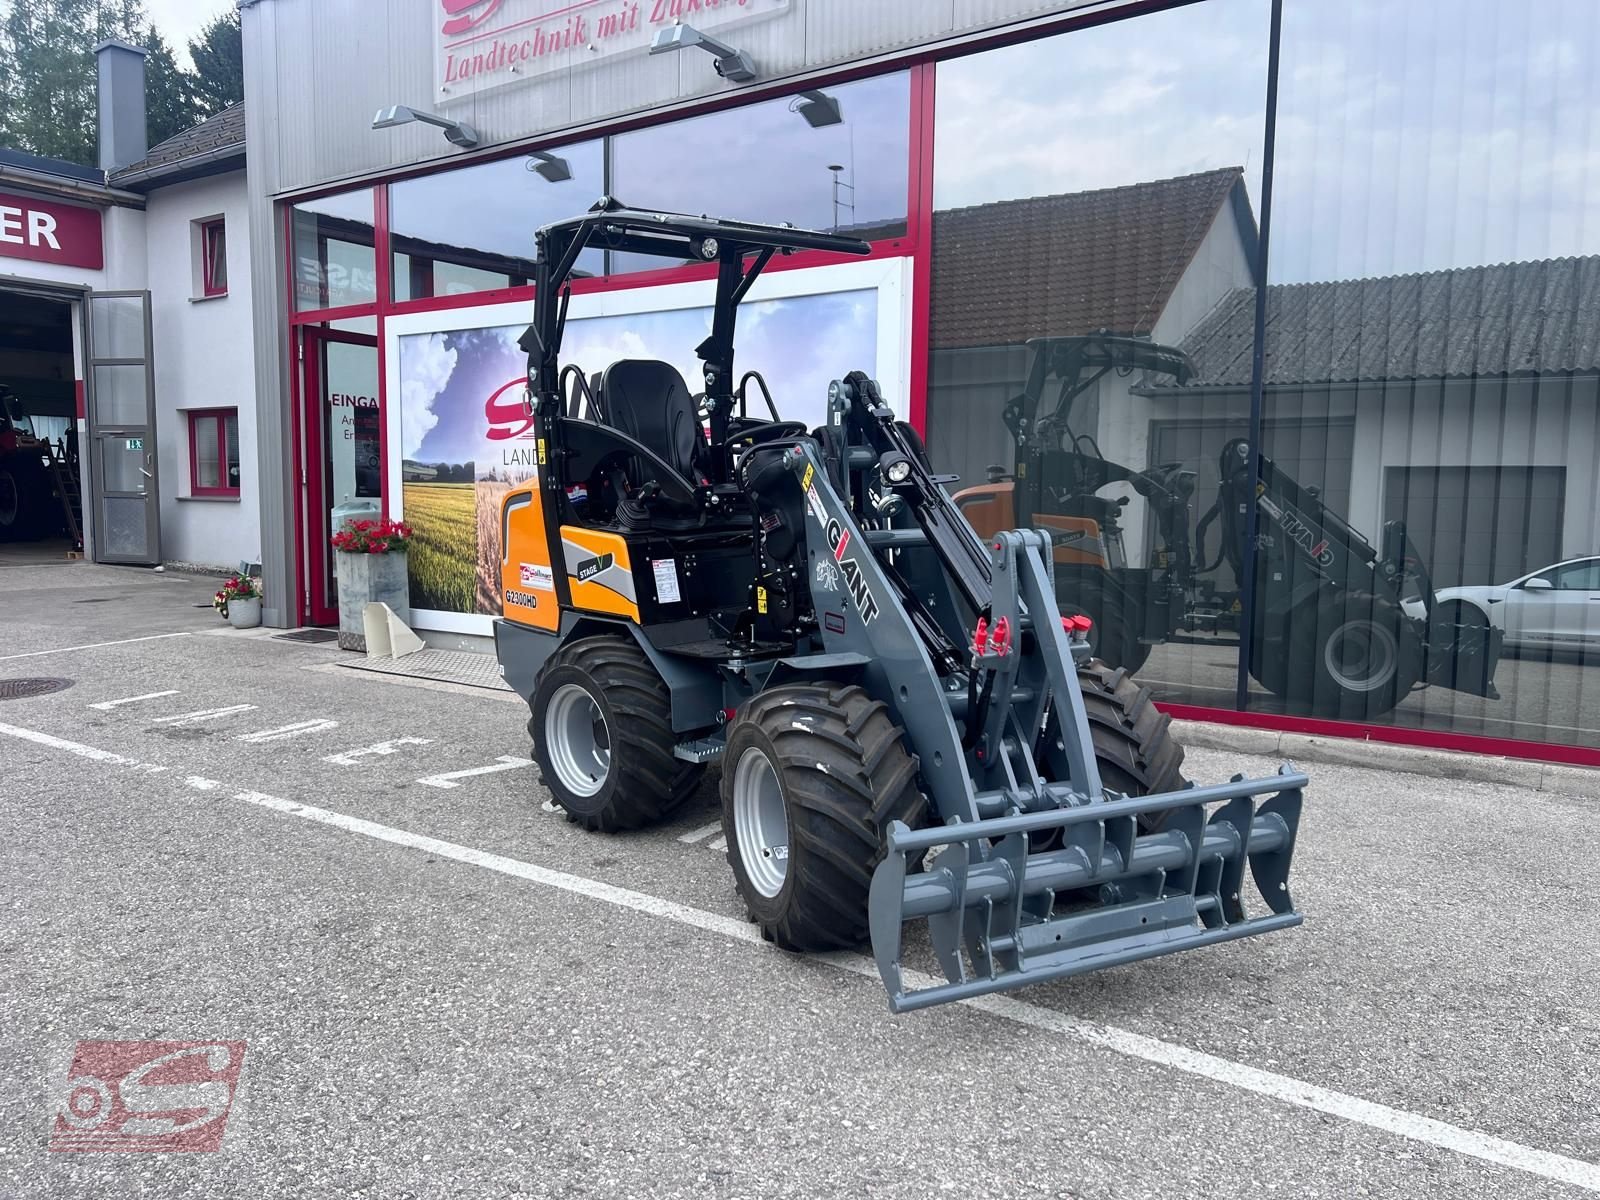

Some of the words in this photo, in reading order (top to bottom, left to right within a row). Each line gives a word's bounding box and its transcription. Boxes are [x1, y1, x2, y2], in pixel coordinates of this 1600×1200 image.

[445, 14, 586, 83] Landtechnik
[597, 1, 639, 38] mit
[0, 205, 61, 250] ER
[332, 394, 378, 408] EINGA
[580, 564, 598, 579] STAGE
[827, 518, 879, 626] GIANT
[505, 590, 537, 608] G2300HD
